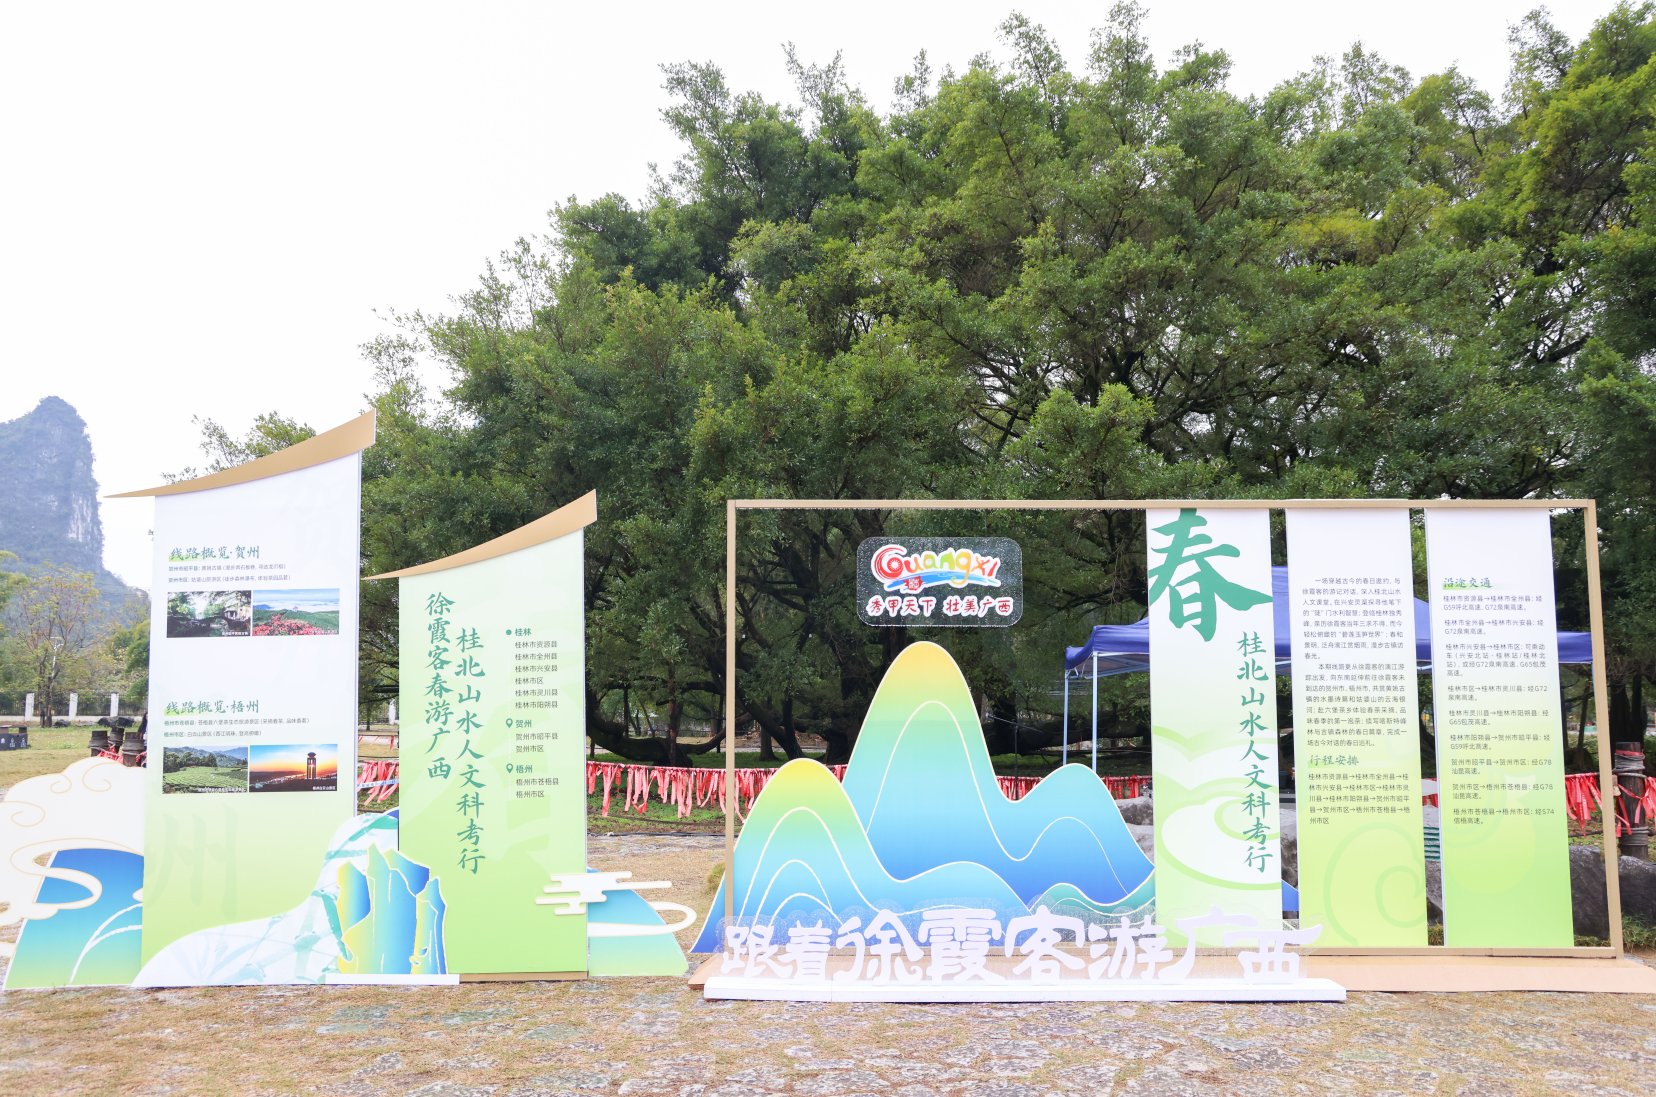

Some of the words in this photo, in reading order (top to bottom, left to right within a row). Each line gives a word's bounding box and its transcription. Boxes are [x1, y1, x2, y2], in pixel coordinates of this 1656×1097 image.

[170, 545, 260, 561] 线路概览·贺州
[874, 547, 999, 585] Guangxi
[1148, 508, 1273, 642] 春
[1443, 577, 1493, 589] 沿途交通
[868, 597, 936, 615] 秀甲天下
[945, 597, 1013, 615] 壮美广西
[515, 628, 532, 637] 桂林
[515, 641, 558, 649] 桂林市资源县
[515, 653, 558, 661] 桂林市全州县
[515, 665, 558, 673] 桂林市兴安县
[515, 677, 544, 685] 桂林市区
[425, 592, 456, 780] 徐霞客春游广西
[515, 689, 558, 697] 桂林市灵川县
[166, 700, 259, 715] 线路概览·梧州
[515, 701, 558, 709] 桂林市阳朔县
[516, 720, 532, 729] 贺州
[516, 732, 559, 741] 贺州市昭平县
[455, 627, 486, 875] 桂北山水人文科考行
[516, 745, 544, 753] 贺州市区
[1236, 631, 1273, 873] 桂北山水人文科考行
[1310, 755, 1360, 766] 行程安排
[516, 765, 533, 774] 梧州
[516, 778, 559, 787] 梧州市苍梧县
[516, 790, 545, 799] 梧州市区
[721, 906, 1323, 984] 跟着徐霞客游广西
